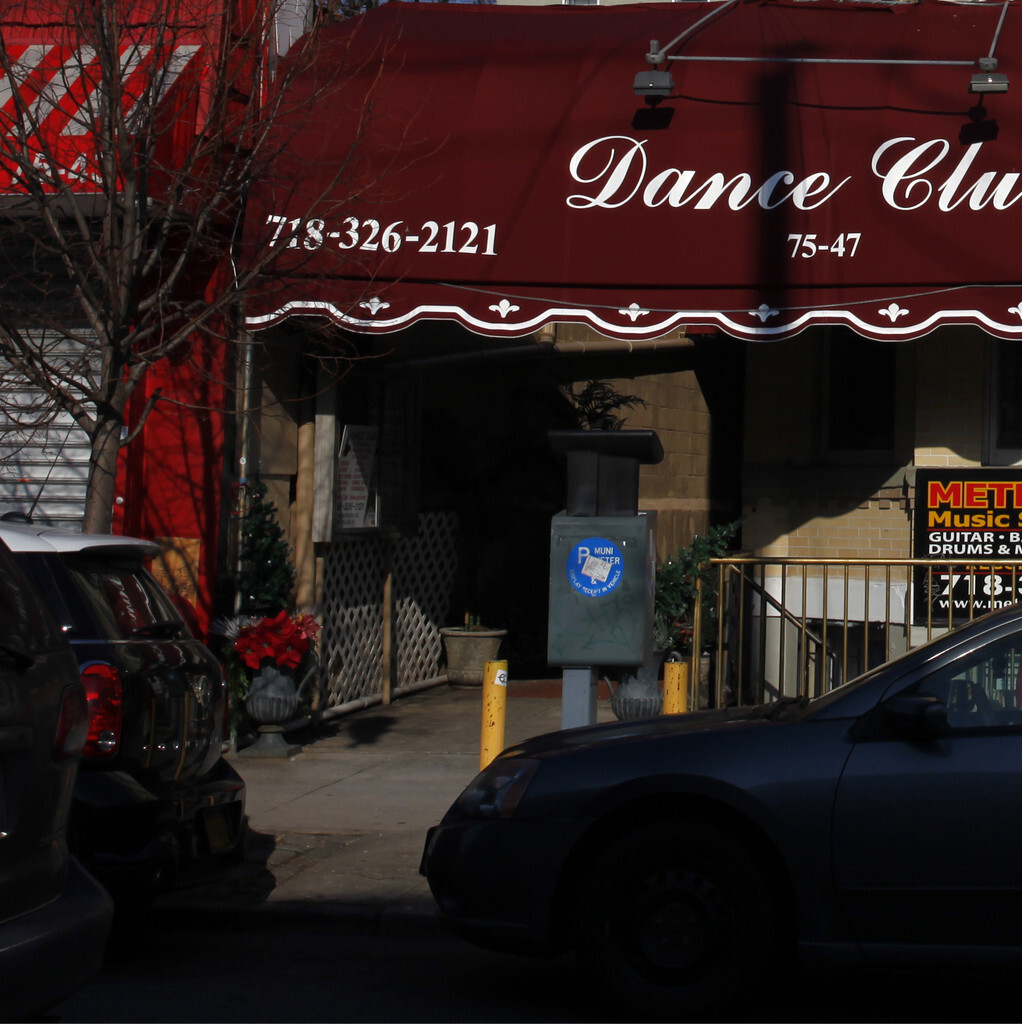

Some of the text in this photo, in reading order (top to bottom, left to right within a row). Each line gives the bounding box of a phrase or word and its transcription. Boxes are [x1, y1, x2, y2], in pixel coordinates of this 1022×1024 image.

[566, 135, 851, 211] Dance
[265, 213, 499, 257] 718-326-2121
[787, 232, 862, 259] 75-47
[928, 510, 1010, 528] Music
[928, 531, 995, 543] GUITAR
[594, 547, 614, 555] MUNI
[928, 544, 994, 555] DRUMS
[997, 544, 1011, 555] &
[607, 570, 621, 589] VEHICLE
